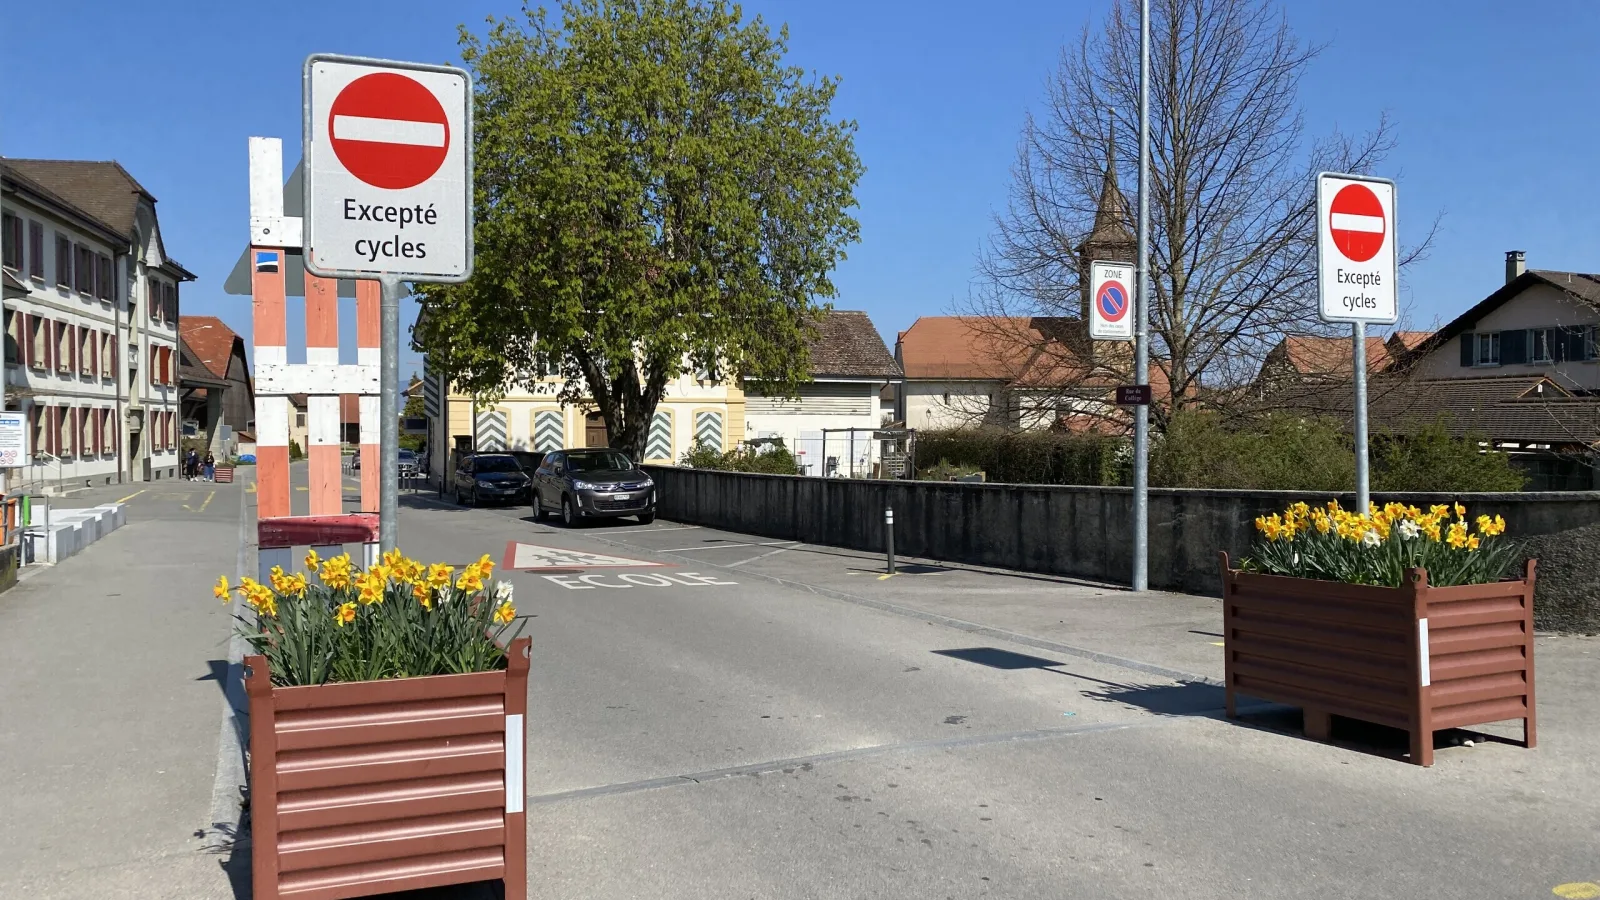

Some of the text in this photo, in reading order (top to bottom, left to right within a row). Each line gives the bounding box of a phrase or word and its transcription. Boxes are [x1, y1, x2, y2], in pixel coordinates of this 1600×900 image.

[344, 198, 437, 229] Excepté
[354, 234, 427, 263] cycles
[1104, 270, 1123, 279] ZONE
[1337, 268, 1381, 289] Excepté
[1342, 292, 1377, 312] cycles
[541, 572, 739, 590] ECOLE
